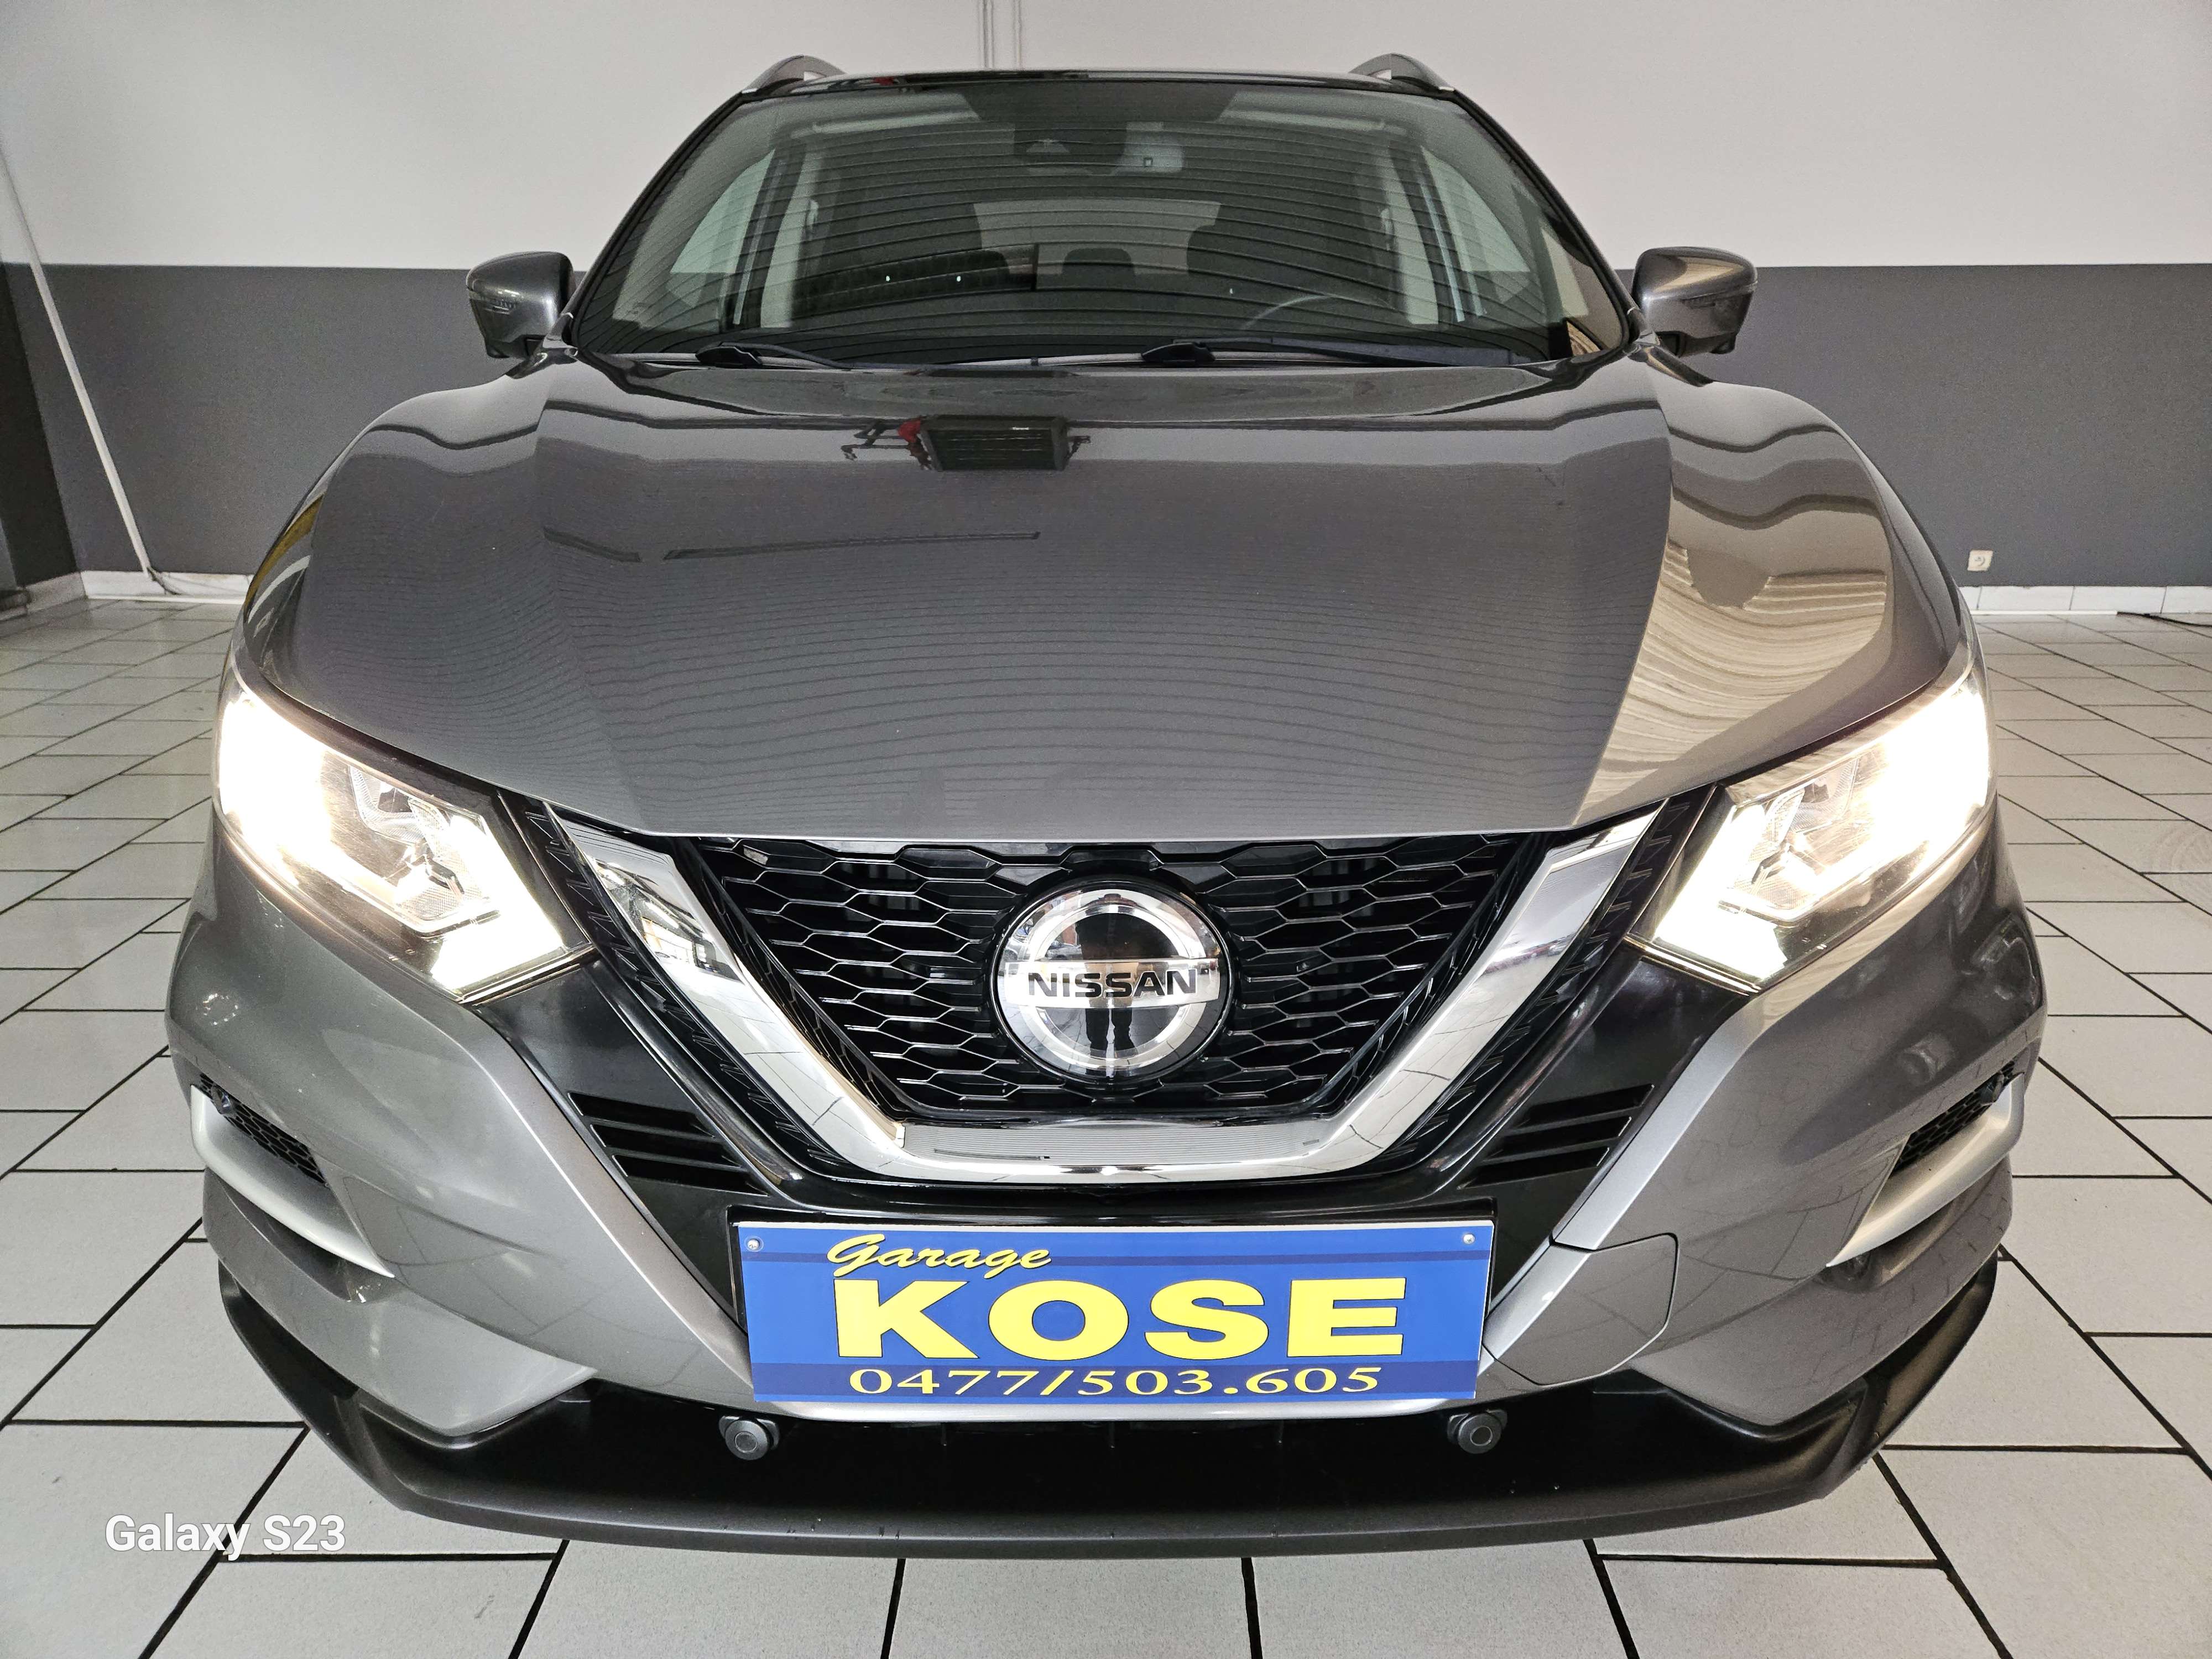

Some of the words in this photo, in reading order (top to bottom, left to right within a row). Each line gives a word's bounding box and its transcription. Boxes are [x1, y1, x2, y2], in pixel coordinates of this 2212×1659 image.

[1028, 968, 1198, 998] NISSAN
[827, 1234, 1051, 1279] Garage
[833, 1277, 1406, 1361] KOSE
[849, 1366, 1381, 1396] 0477/503.605
